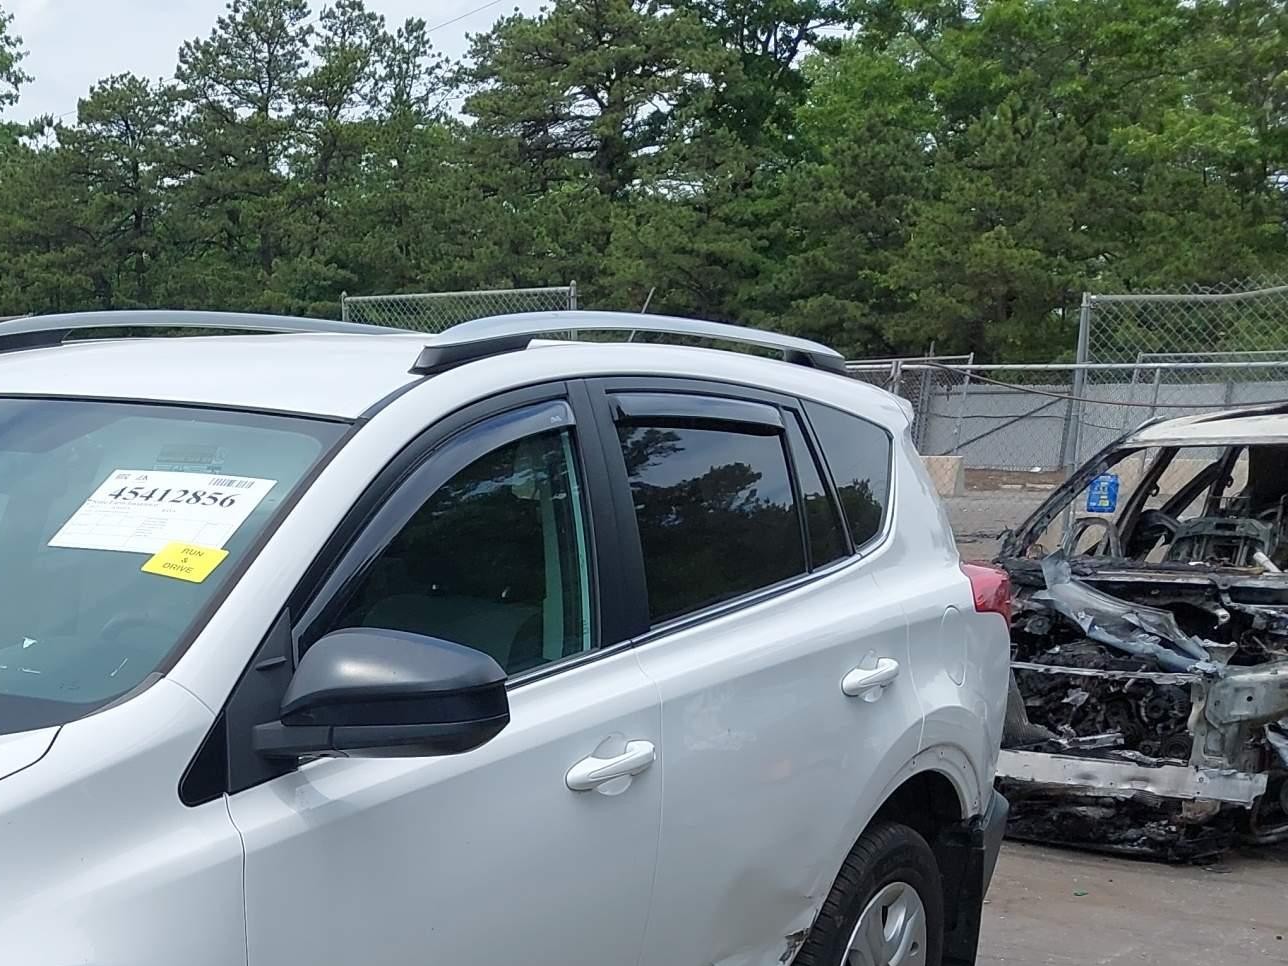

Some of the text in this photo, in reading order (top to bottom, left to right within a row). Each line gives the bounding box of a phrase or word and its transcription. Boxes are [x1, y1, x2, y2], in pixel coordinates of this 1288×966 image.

[108, 486, 241, 509] 45412856
[181, 547, 205, 557] RUN
[162, 562, 195, 574] DRIVE
